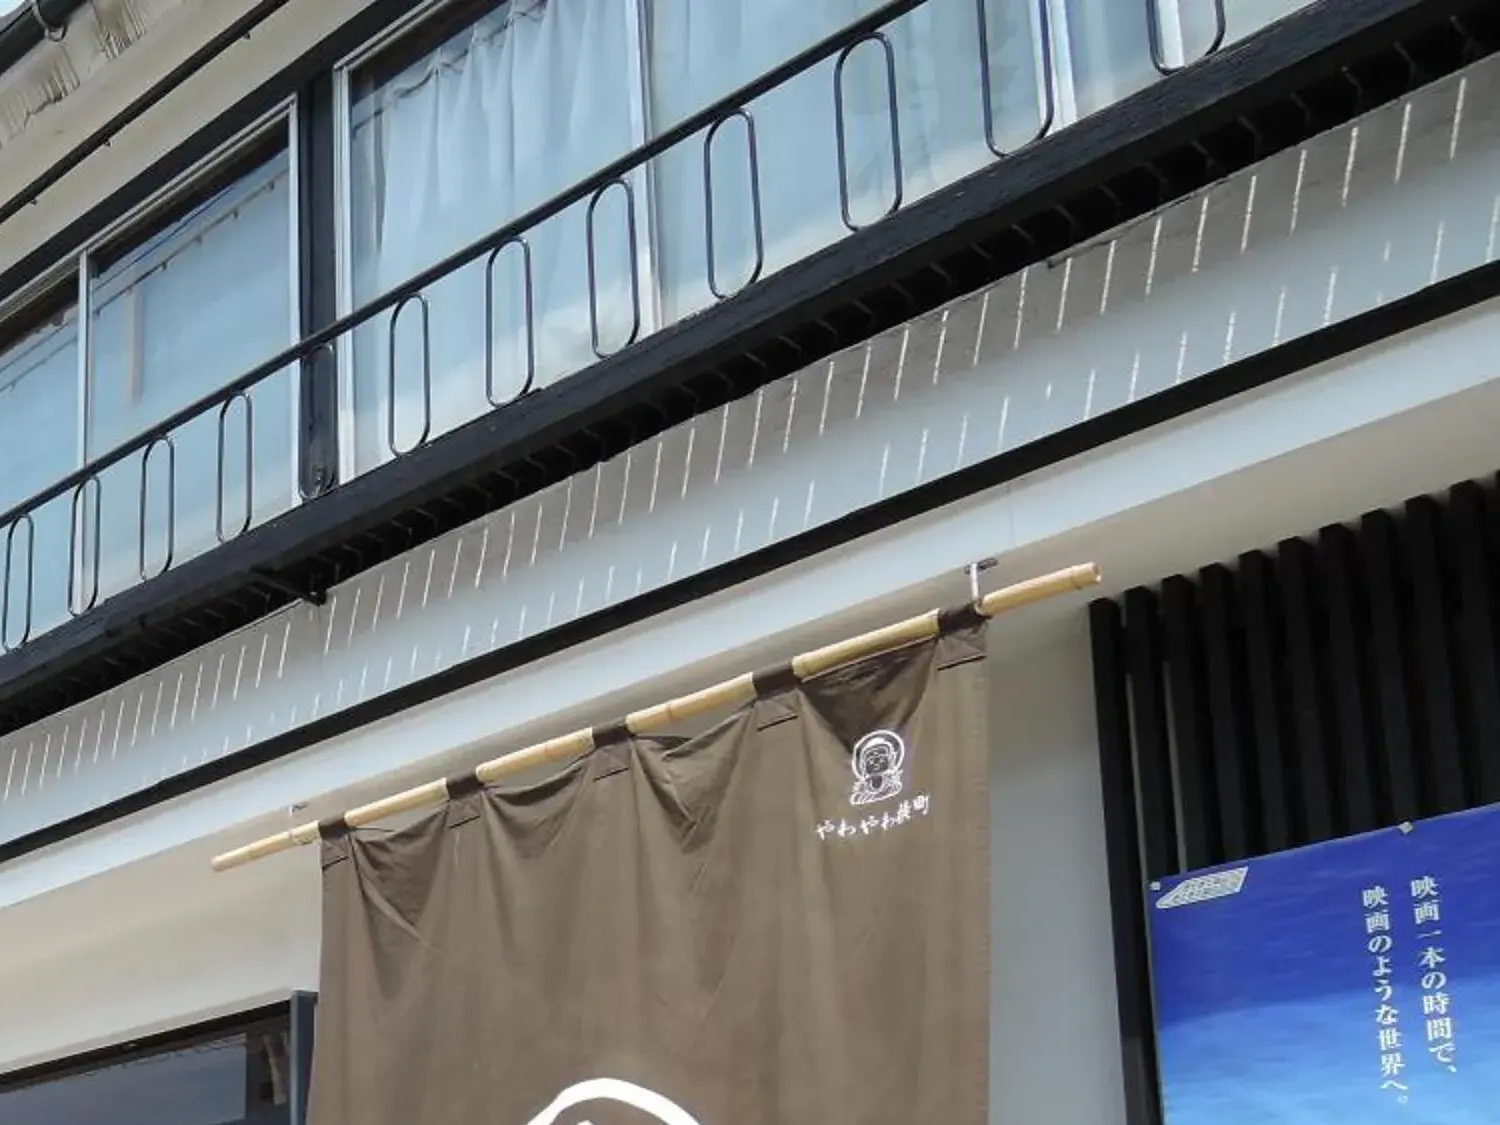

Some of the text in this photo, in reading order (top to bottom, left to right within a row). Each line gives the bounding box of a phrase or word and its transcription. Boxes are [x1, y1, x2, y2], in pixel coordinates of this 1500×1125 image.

[1361, 886, 1409, 1104] 映画のような世界へ。
[1410, 874, 1457, 1073] 映画一本の時間で、
